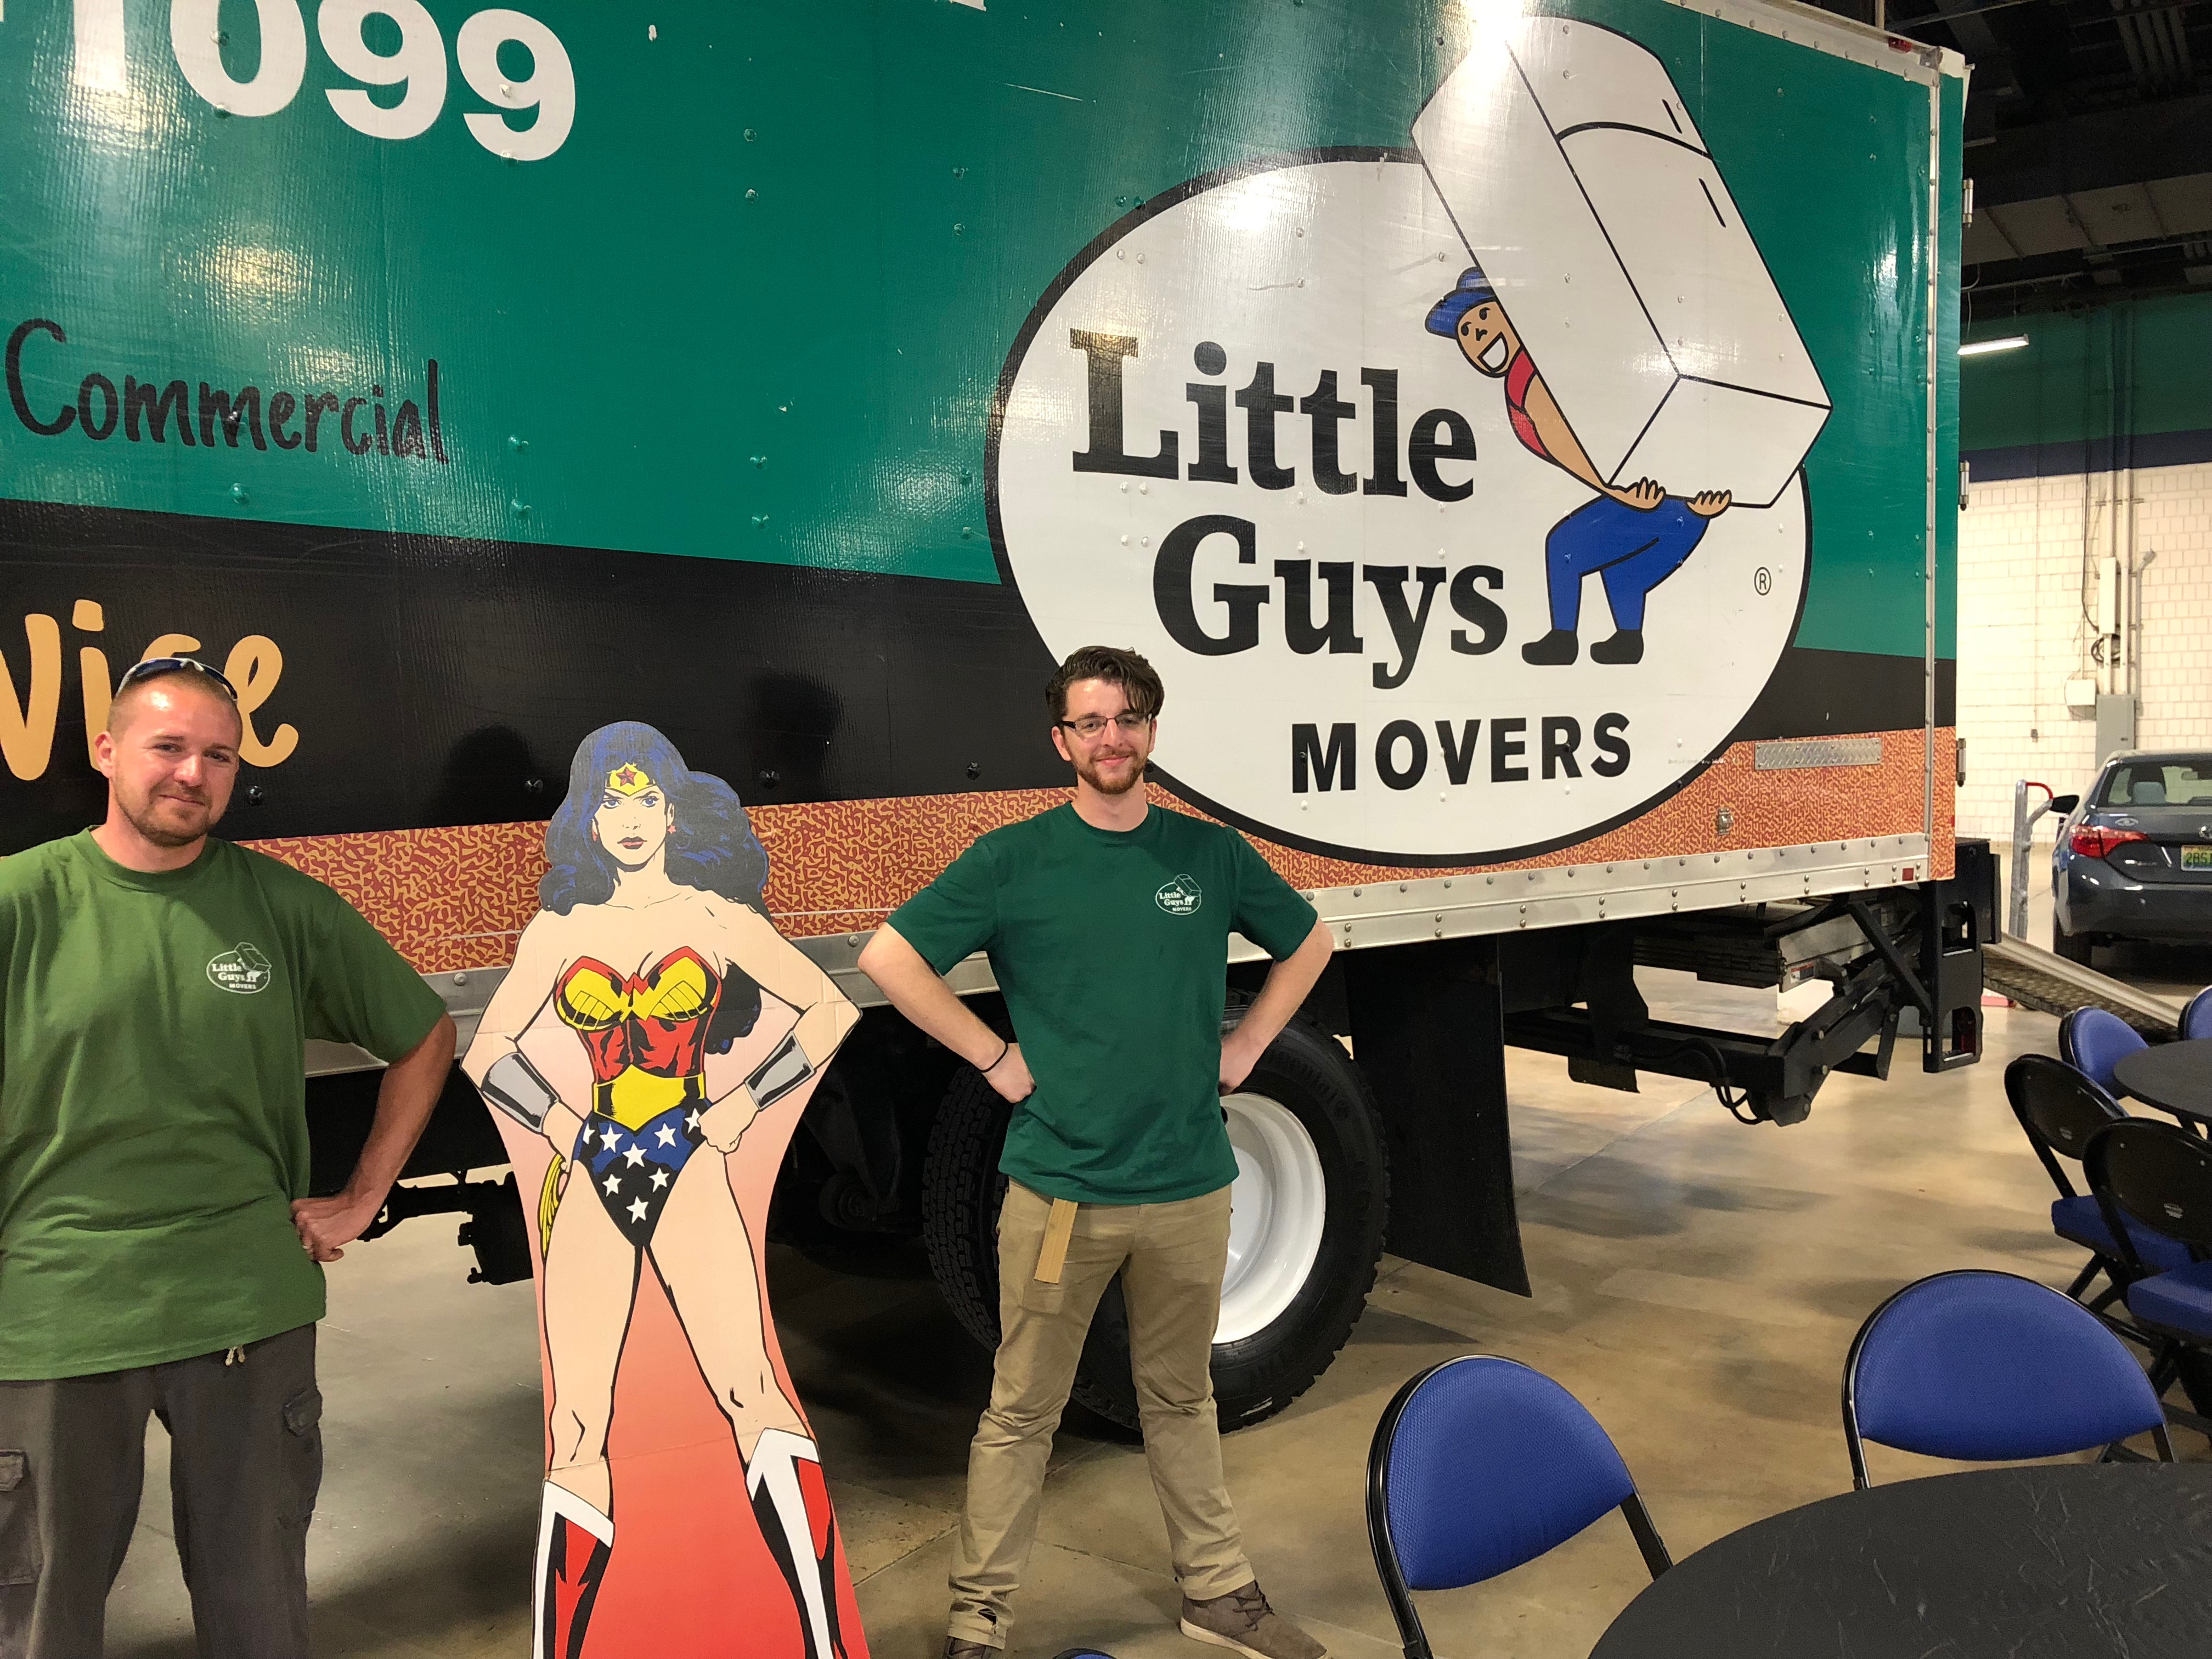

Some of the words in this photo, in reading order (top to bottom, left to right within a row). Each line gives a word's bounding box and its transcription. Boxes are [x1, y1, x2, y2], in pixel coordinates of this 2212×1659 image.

[5, 318, 449, 464] Commercial
[1070, 328, 1477, 503] Little
[1153, 514, 1508, 690] Guys
[1292, 712, 1630, 793] MOVERS
[212, 963, 242, 972] Little
[218, 972, 245, 982] Guys
